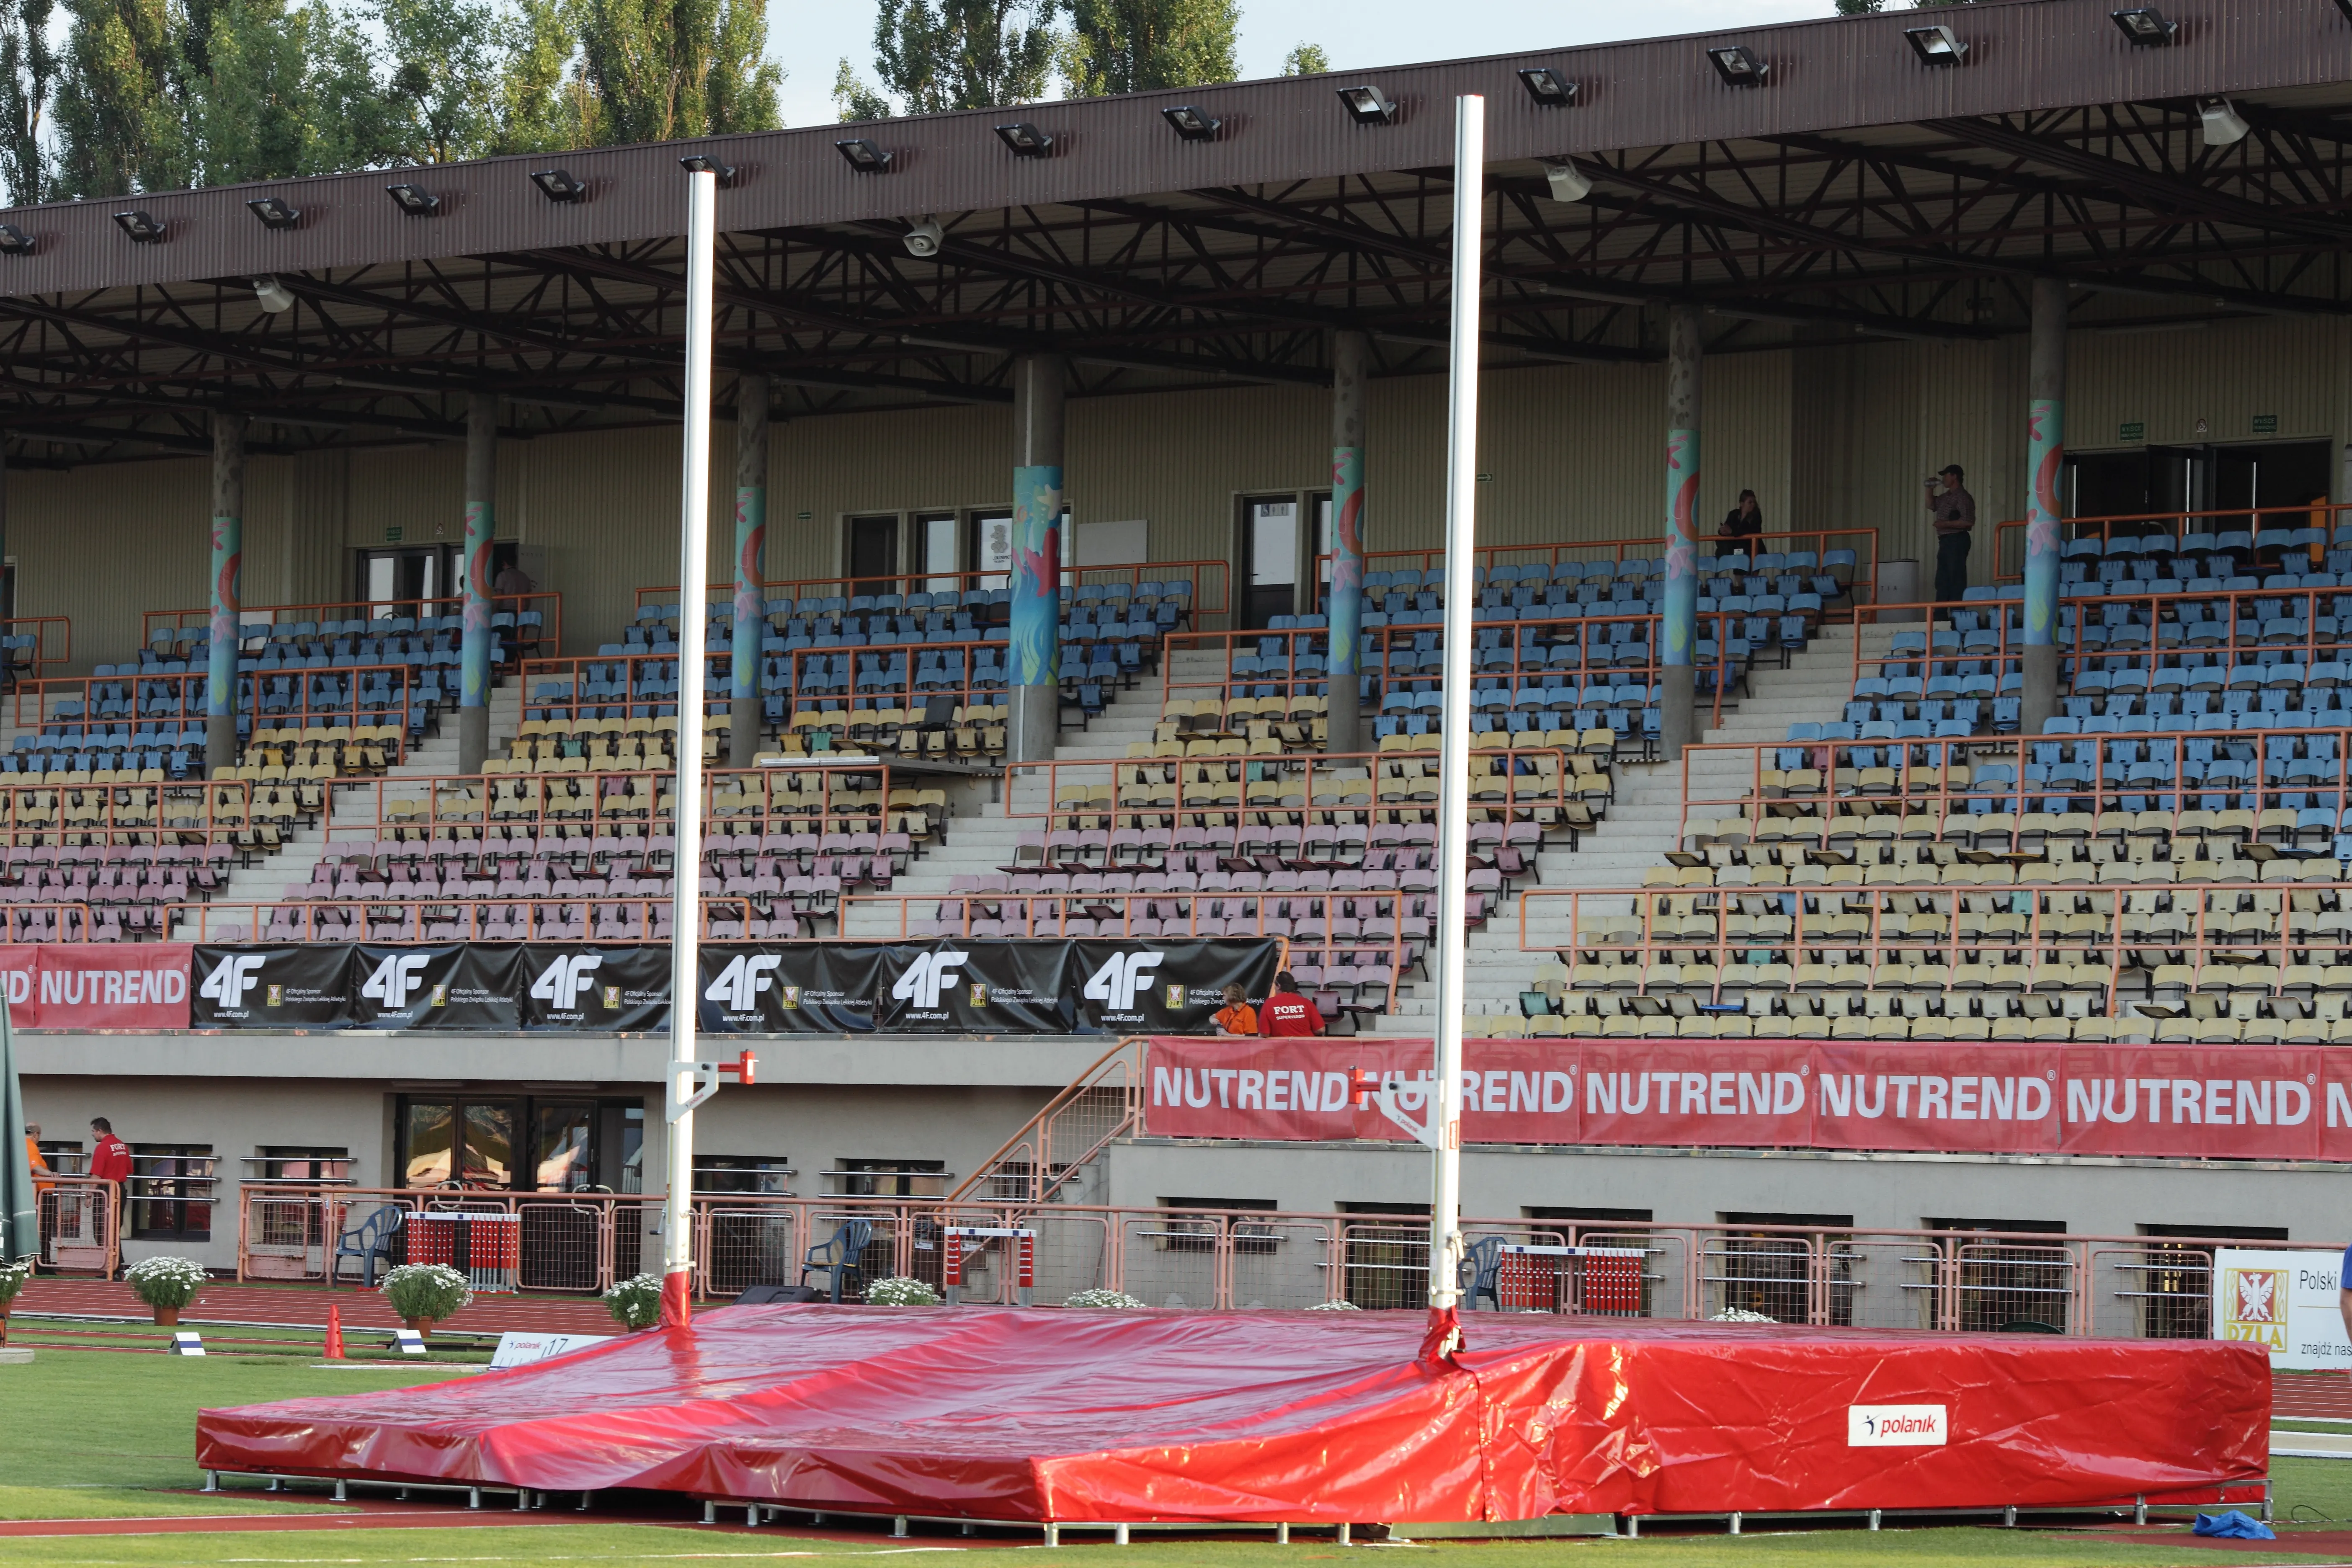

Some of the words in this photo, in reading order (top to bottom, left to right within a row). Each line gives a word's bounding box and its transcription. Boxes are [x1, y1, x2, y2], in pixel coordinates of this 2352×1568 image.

[201, 955, 266, 1007] 4F
[362, 955, 430, 1007] 4F
[530, 955, 603, 1008] 4F
[705, 955, 781, 1010] 4F
[892, 952, 969, 1007] 4F
[1084, 952, 1164, 1009] 4F
[214, 1011, 249, 1019] www.4F.com.pl
[377, 1011, 413, 1019] www.4F.com.pl
[547, 1012, 584, 1021] www.4F.com.pl
[722, 1014, 765, 1022] www.4F.com.pl
[905, 1011, 949, 1021] www.4F.com.pl
[1101, 1014, 1145, 1023] www.4F.com.pl
[1273, 1005, 1305, 1014] FORT
[1153, 1067, 1348, 1112] NUTREND
[2299, 1270, 2337, 1291] Polski
[514, 1341, 542, 1350] polanik
[2227, 1324, 2283, 1348] PZLA
[548, 1338, 569, 1355] 17
[2301, 1341, 2331, 1358] znajdź
[2335, 1345, 2352, 1356] nas
[1880, 1415, 1937, 1438] polanik
